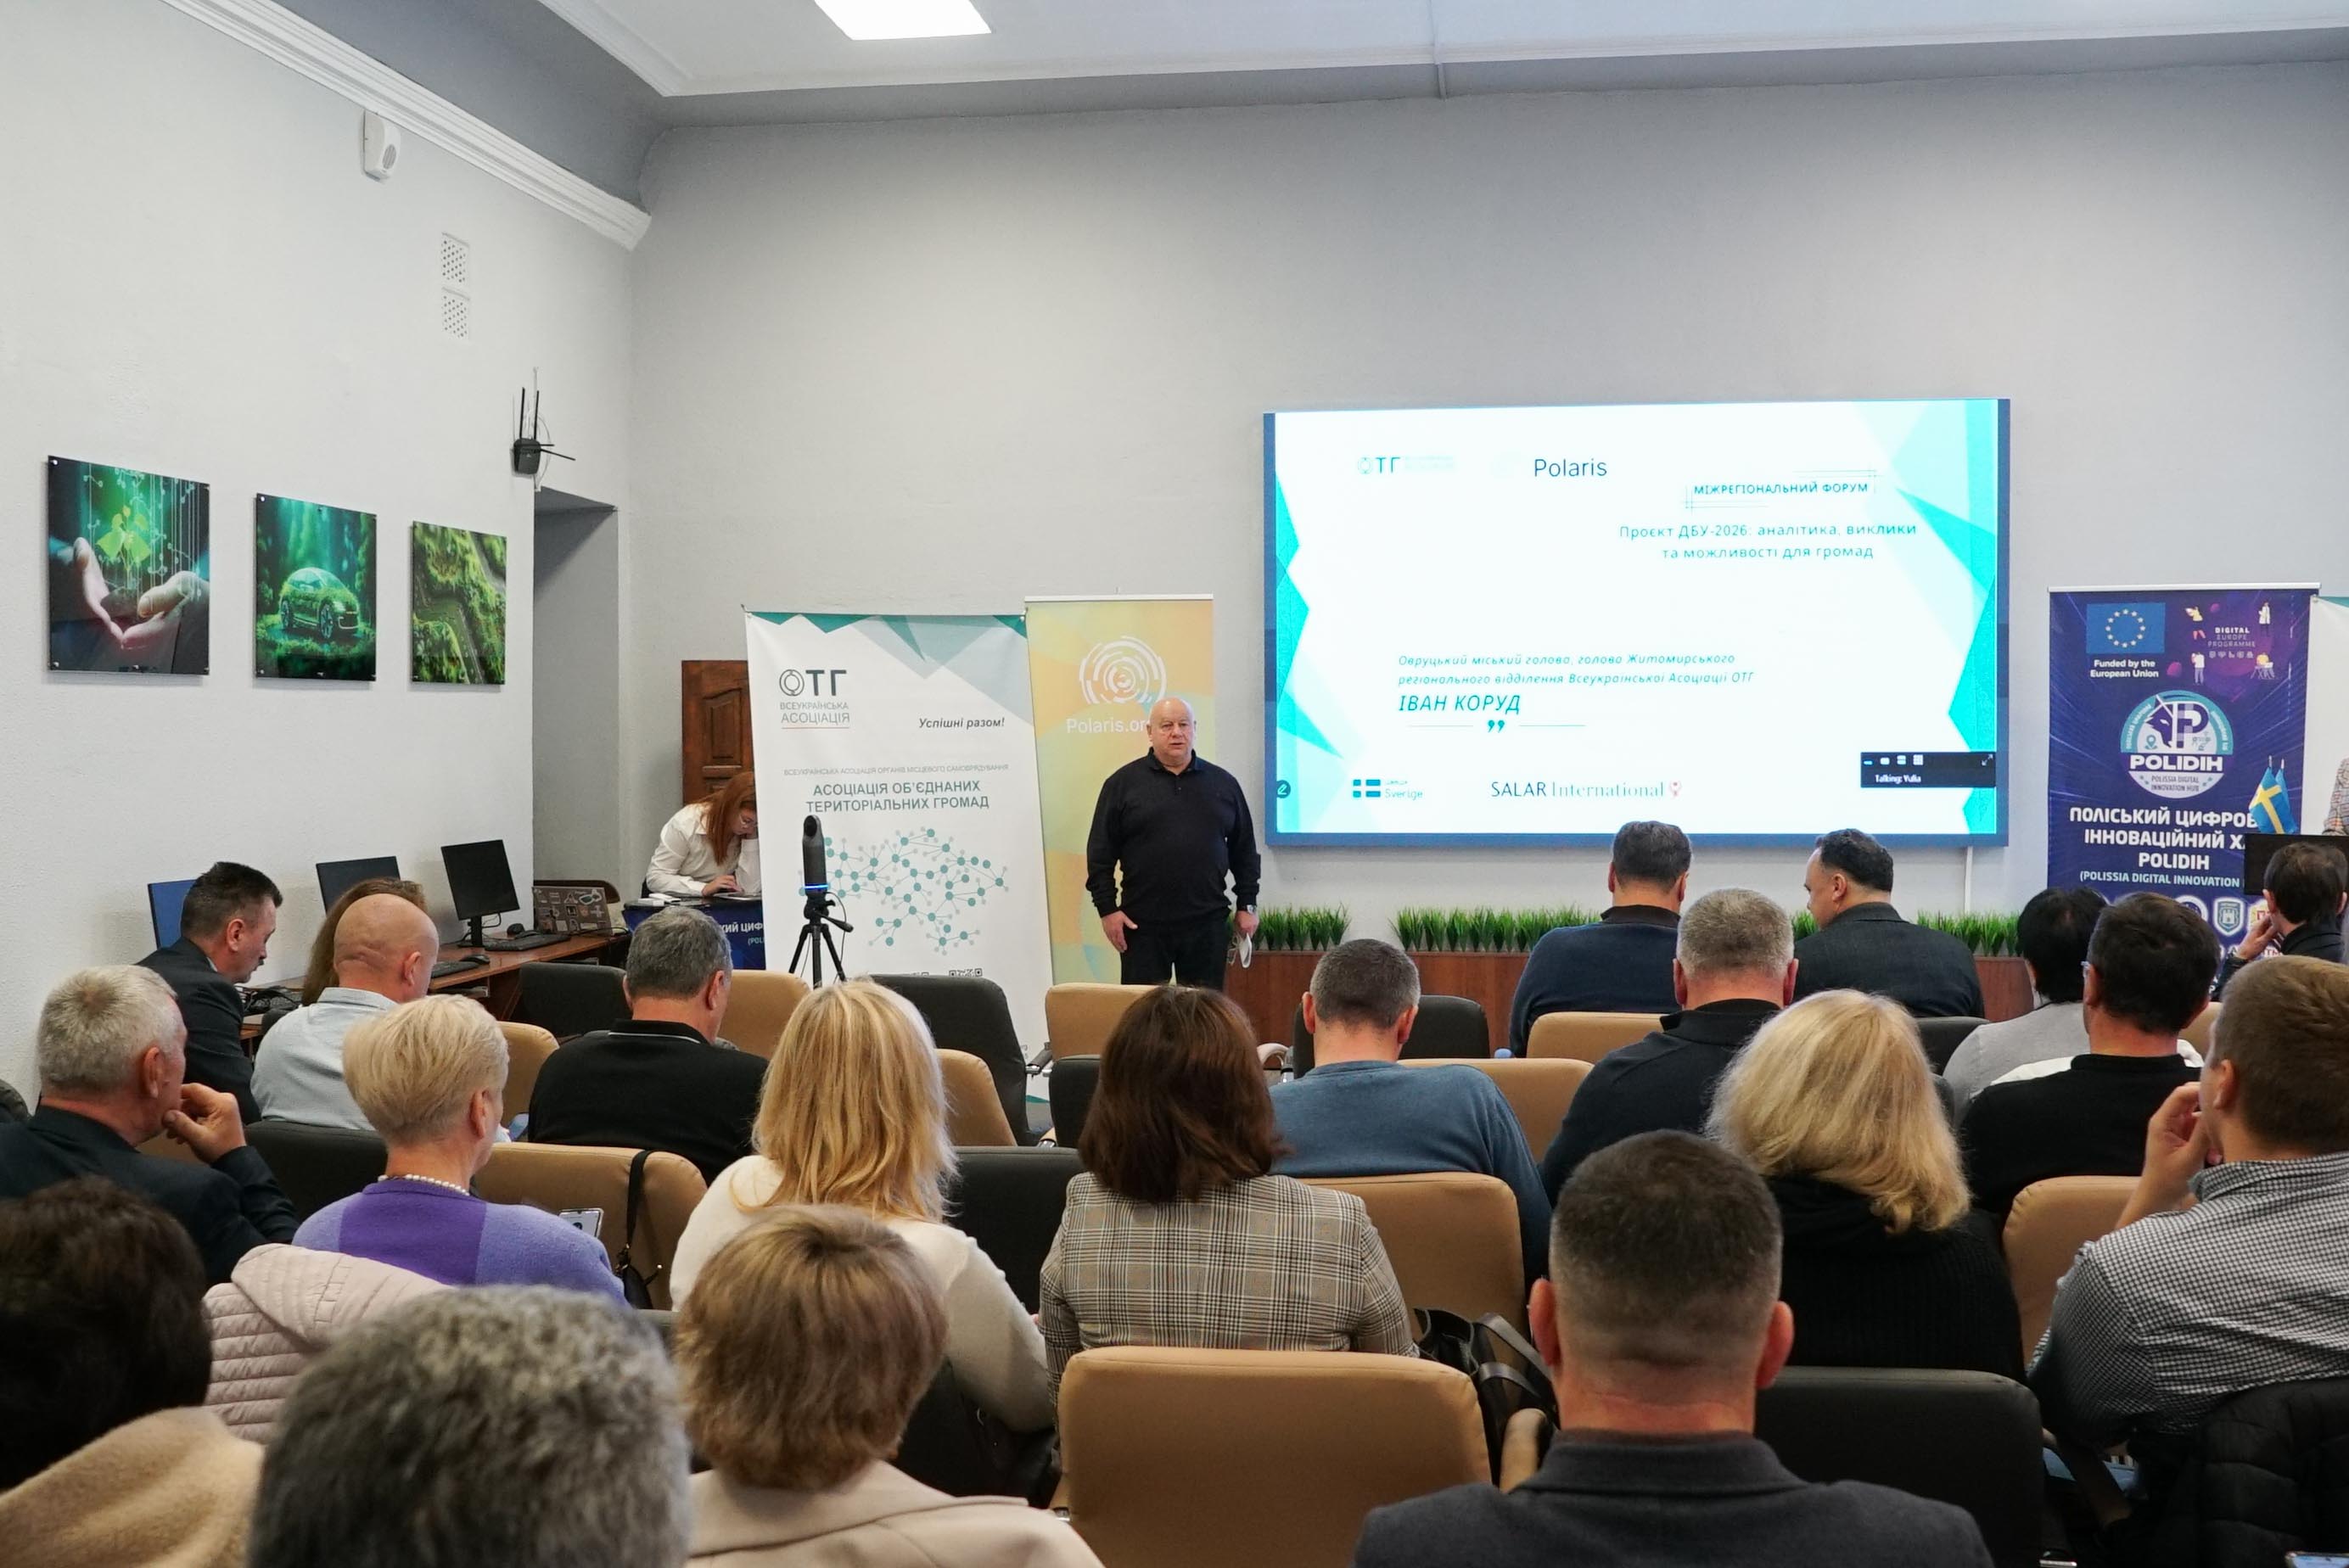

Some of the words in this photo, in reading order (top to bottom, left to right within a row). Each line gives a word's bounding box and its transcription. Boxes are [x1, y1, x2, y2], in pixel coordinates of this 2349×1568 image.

[1533, 457, 1608, 477] Polaris
[1694, 481, 1818, 495] МІЖРЕГІОНАЛЬНИЙ
[1822, 483, 1868, 493] ФОРУМ
[1619, 526, 1674, 540] Проєкт
[1678, 524, 1752, 540] ДБУ-2026:
[1758, 525, 1841, 537] аналітика,
[1847, 524, 1917, 535] виклики
[1663, 549, 1679, 558] та
[1684, 548, 1778, 558] можливості
[1783, 547, 1811, 560] для
[1816, 547, 1874, 561] громад
[1399, 654, 1468, 668] Овруцький
[1472, 654, 1522, 665] міський
[1525, 656, 1574, 666] голова,
[1578, 655, 1623, 664] голова
[1627, 653, 1735, 666] Житомирського
[2094, 658, 2127, 668] Funded
[2128, 659, 2140, 669] by
[2141, 659, 2156, 668] the
[1399, 675, 1491, 687] регіонального
[1495, 673, 1564, 685] відділення
[1731, 671, 1754, 683] ОТГ
[2090, 669, 2131, 679] European
[2132, 669, 2160, 678] Union
[779, 669, 847, 697] ОТГ
[780, 701, 849, 710] ВСЕУКРАЇНСЬКА
[1399, 694, 1448, 712] ІВАН
[1455, 694, 1521, 715] КОРУД
[781, 712, 850, 725] АСОЦІАЦІЯ
[919, 717, 964, 728] Успішні
[967, 716, 1006, 730] разом!
[1066, 717, 1151, 734] Polaris.or
[2129, 754, 2223, 771] POLIDIH
[813, 782, 889, 797] АСОЦІАЦІЯ
[892, 780, 981, 795] ОБ'ЄДНАНИХ
[1491, 781, 1547, 798] SALAR
[1551, 781, 1664, 798] International
[805, 798, 930, 812] ТЕРИТОРІАЛЬНИХ
[933, 795, 989, 809] ГРОМАД
[2070, 806, 2171, 826] ПОЛІСЬКИЙ
[2175, 809, 2257, 828] ЦИФРОВ
[2084, 828, 2225, 849] ІННОВАЦІЙНИЙ
[2138, 852, 2210, 871] POLIDIH
[2080, 870, 2130, 883] (POLISSIA
[2131, 872, 2172, 885] DIGITAL
[2173, 874, 2240, 888] INNOVATION
[740, 921, 765, 932] ЦИФ
